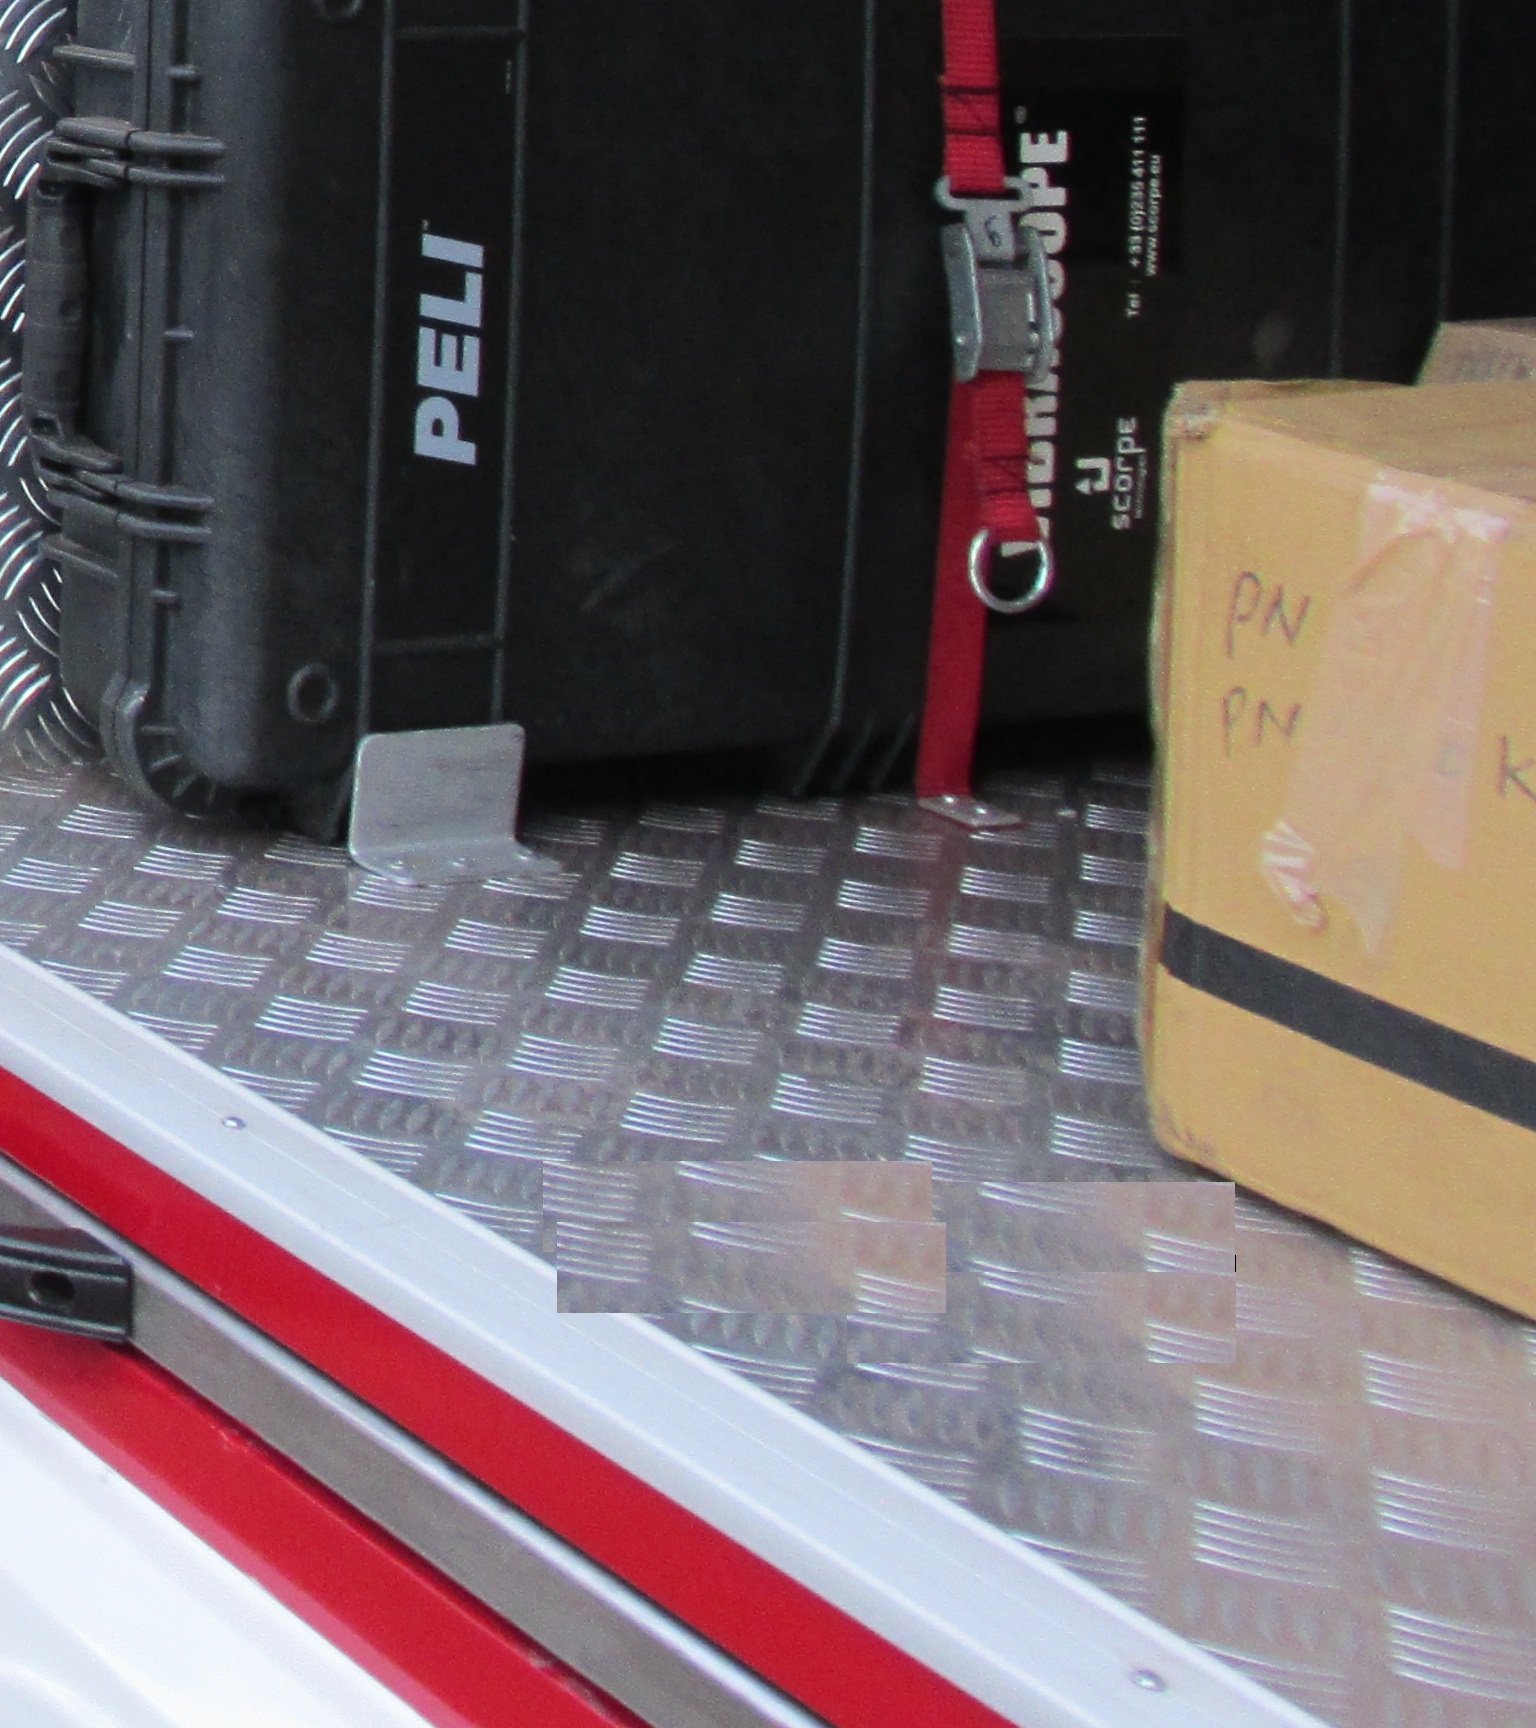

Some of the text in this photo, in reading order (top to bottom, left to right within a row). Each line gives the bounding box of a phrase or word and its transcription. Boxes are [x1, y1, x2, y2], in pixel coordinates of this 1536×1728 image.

[414, 232, 485, 466] PELI
[1111, 417, 1147, 530] scorpe
[1225, 570, 1312, 660] PN
[1222, 685, 1303, 758] PN
